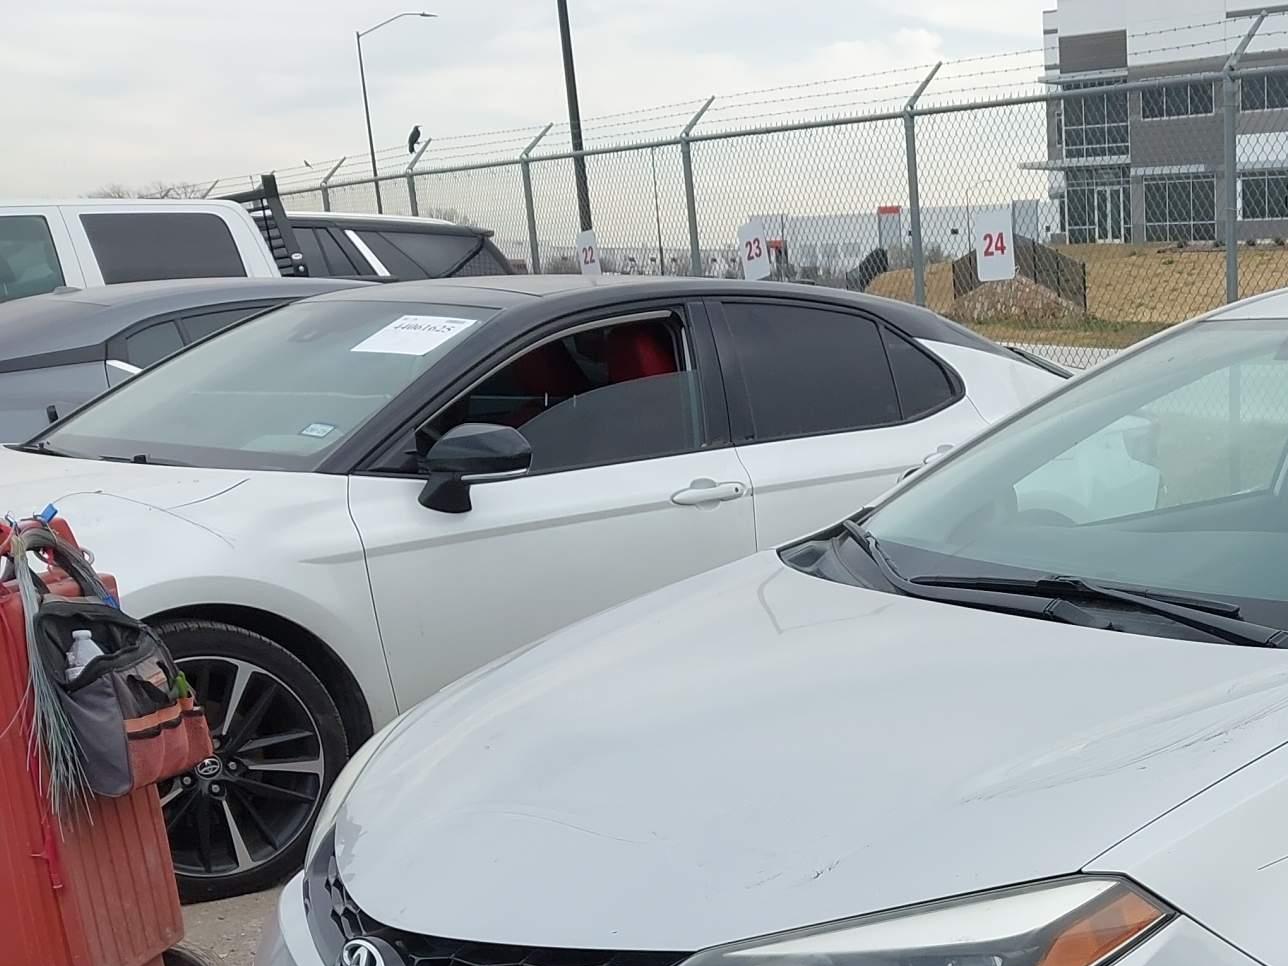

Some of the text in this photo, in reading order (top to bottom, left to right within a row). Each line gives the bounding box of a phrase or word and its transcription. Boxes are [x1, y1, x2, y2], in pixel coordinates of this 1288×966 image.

[582, 246, 596, 265] 22
[745, 237, 762, 261] 23
[983, 231, 1007, 257] 24
